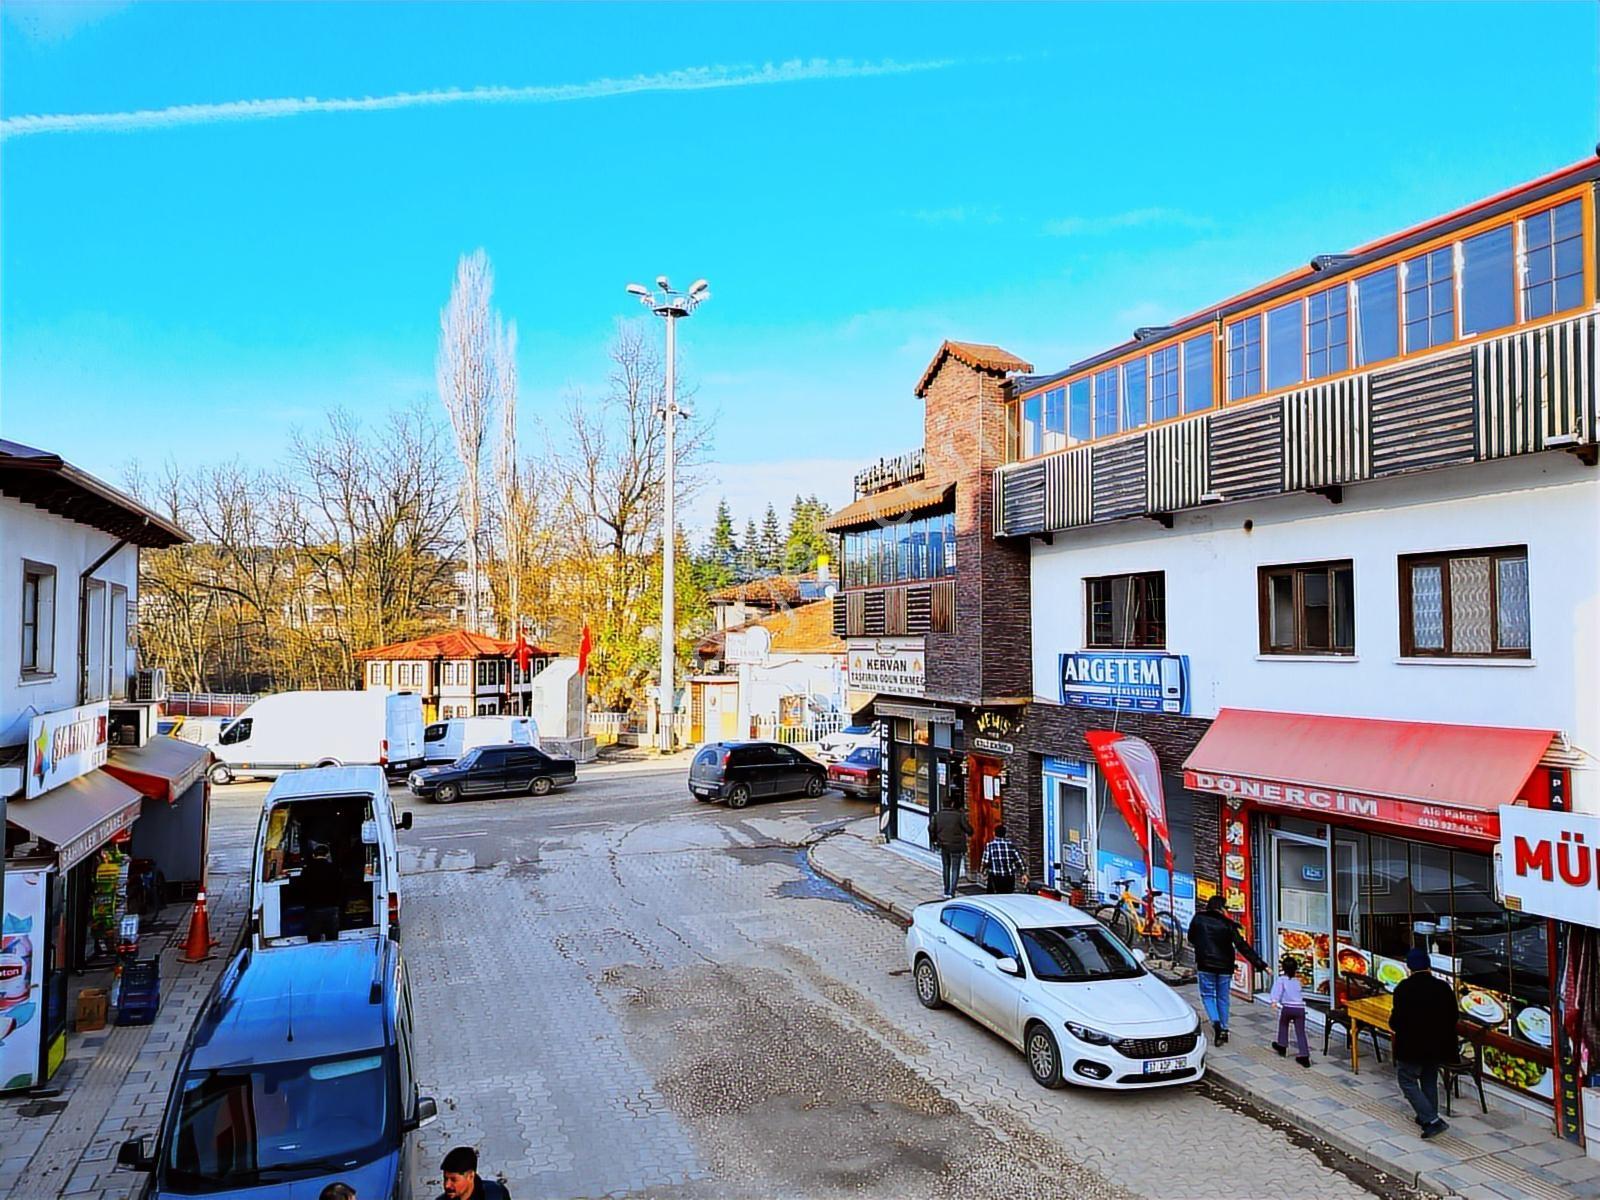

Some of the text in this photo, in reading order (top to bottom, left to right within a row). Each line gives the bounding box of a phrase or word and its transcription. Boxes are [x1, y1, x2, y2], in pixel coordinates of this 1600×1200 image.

[866, 659, 907, 671] KERVAN
[1065, 658, 1160, 685] ARGETEM
[881, 724, 889, 806] EKMEK
[1196, 772, 1378, 817] DÖNERCİM
